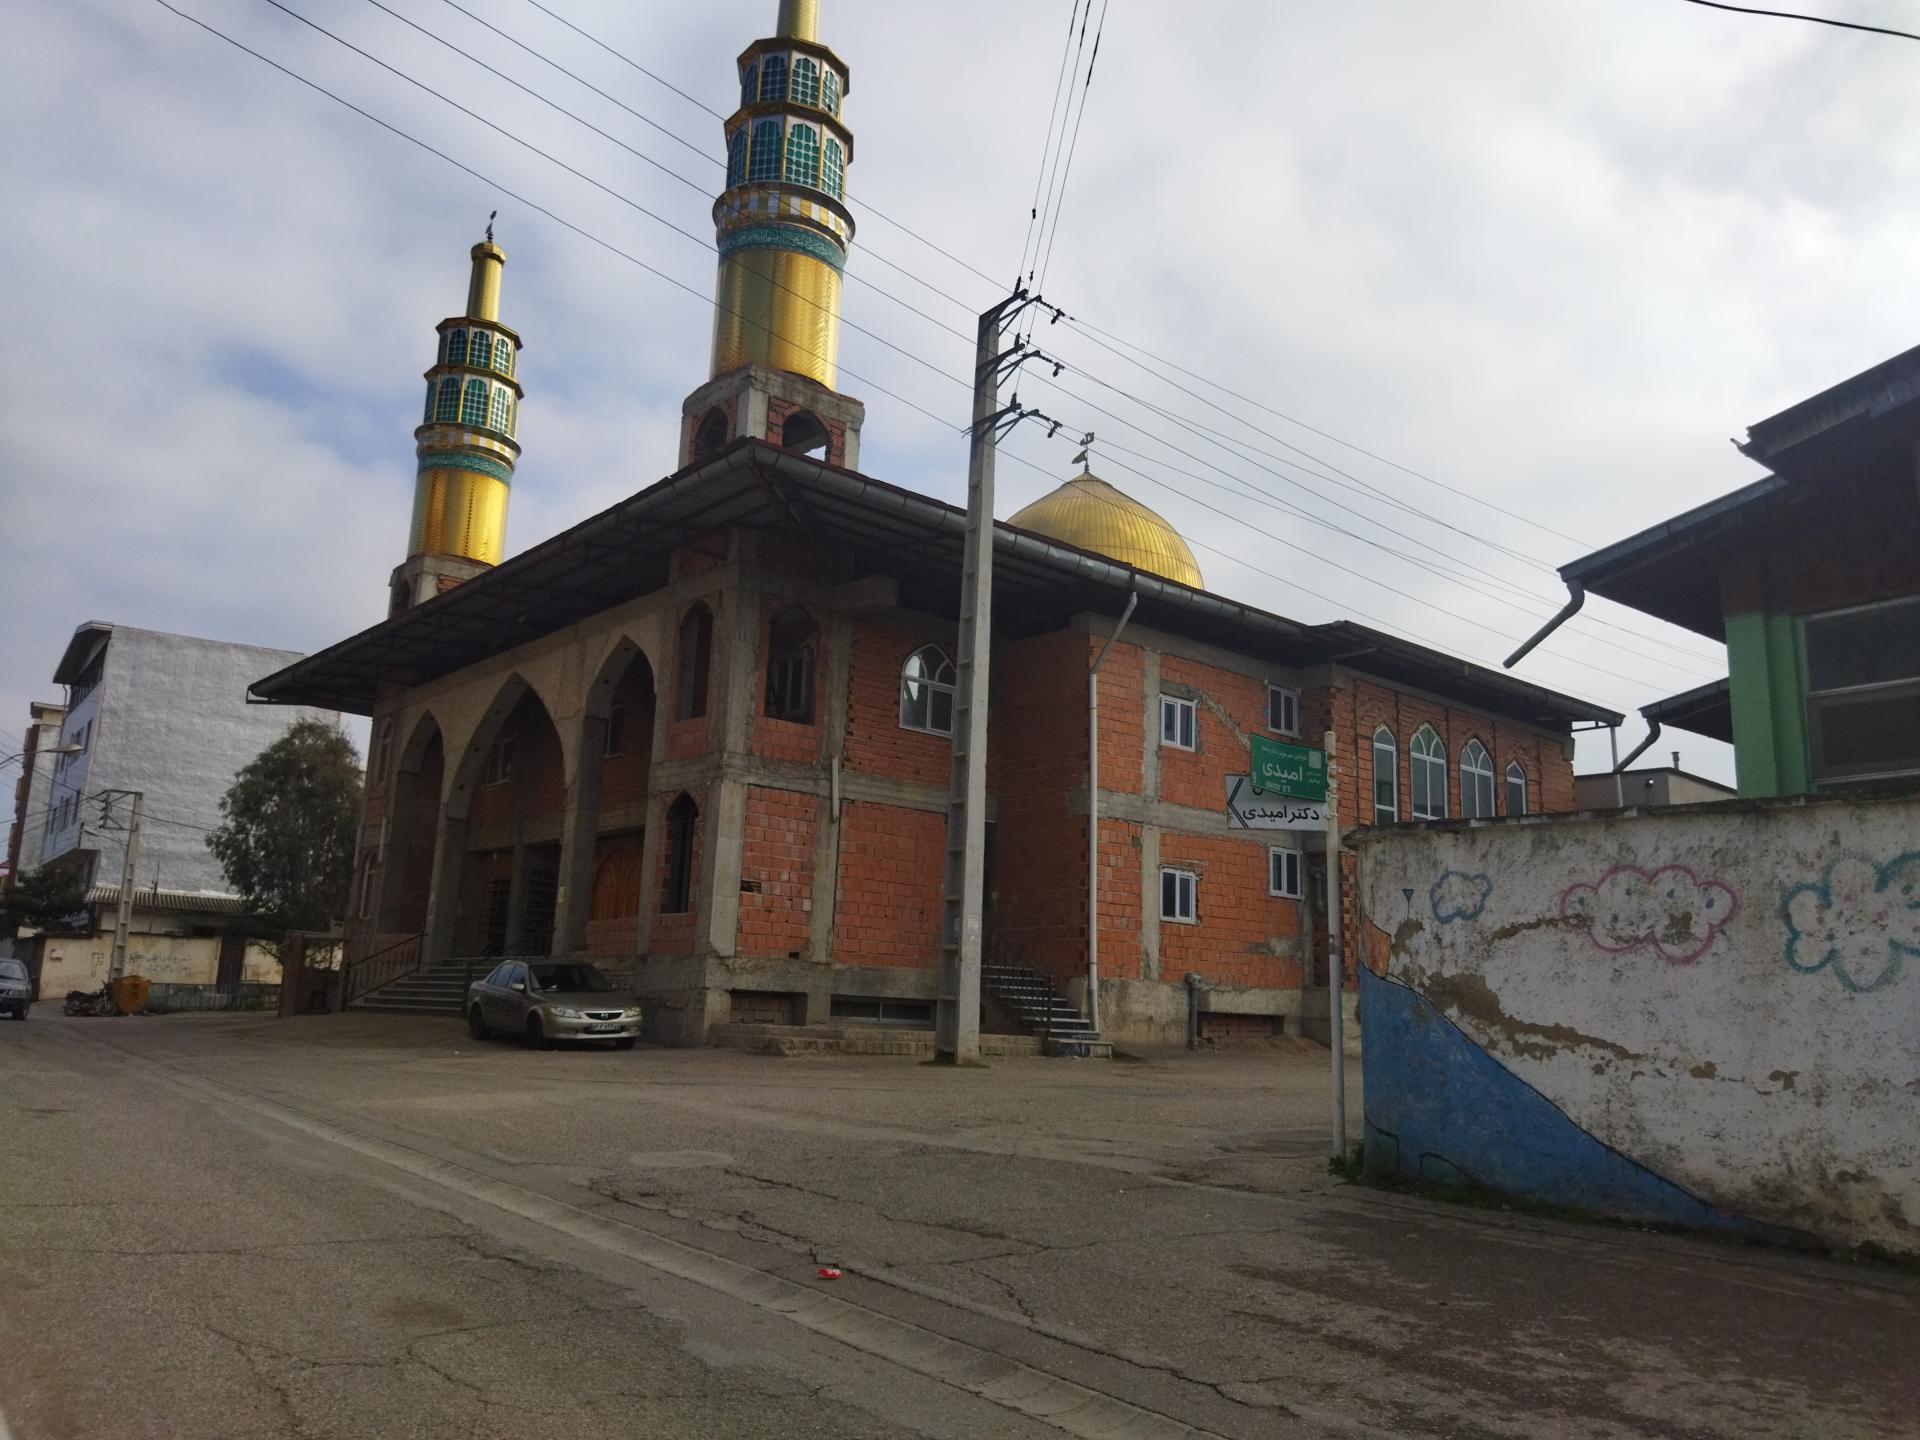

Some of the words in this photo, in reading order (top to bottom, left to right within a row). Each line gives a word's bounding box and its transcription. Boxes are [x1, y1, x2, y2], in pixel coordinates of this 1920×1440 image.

[1262, 762, 1303, 783] امیدی
[1243, 805, 1287, 822] امیدی
[1288, 807, 1320, 824] دکتر
